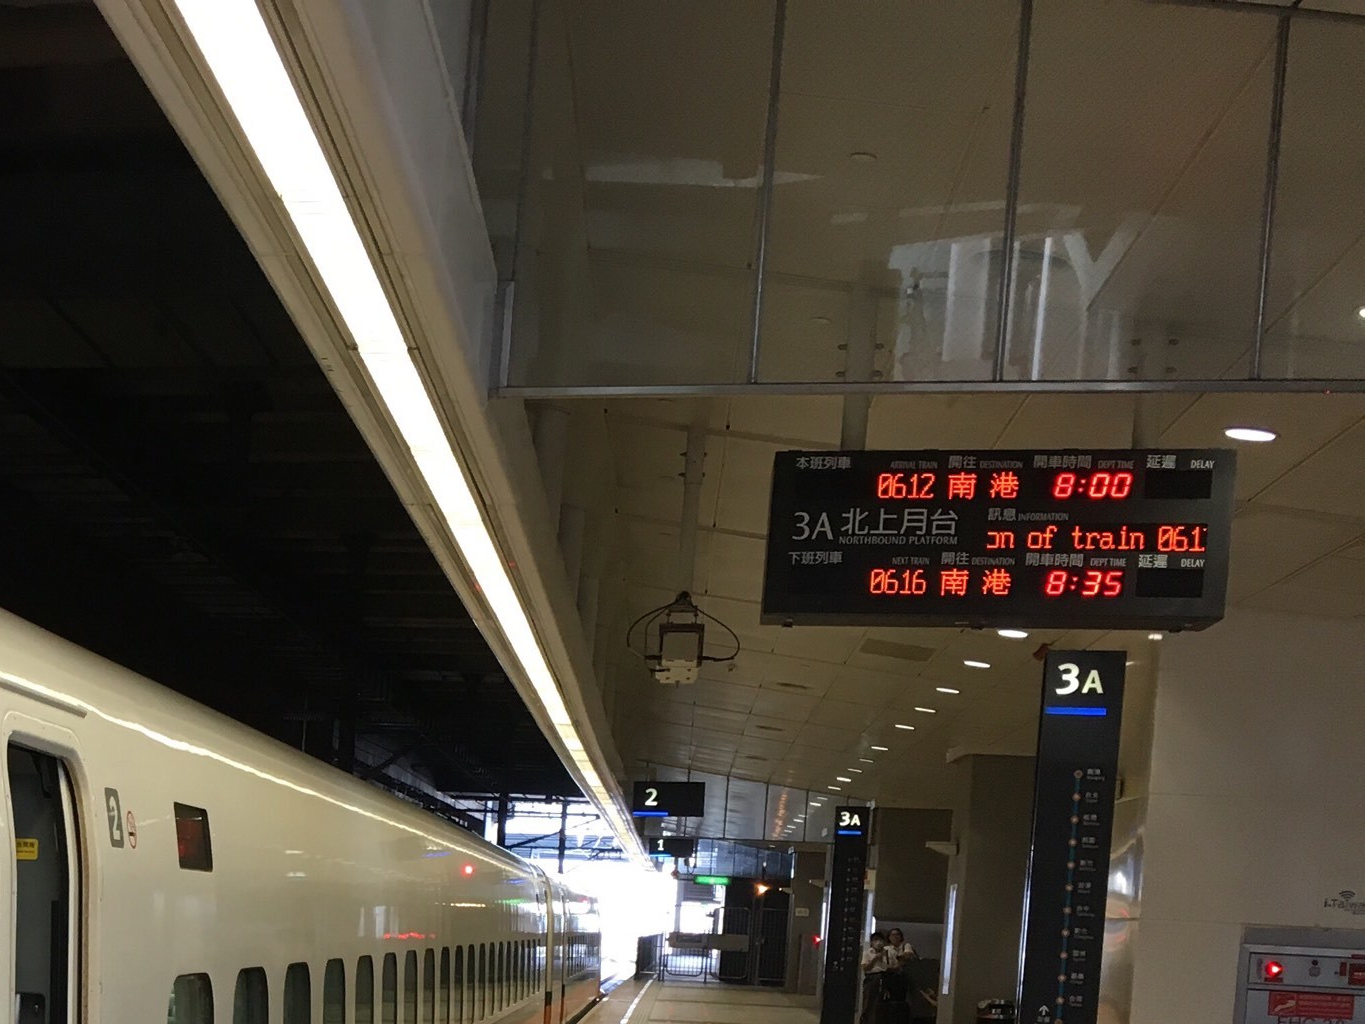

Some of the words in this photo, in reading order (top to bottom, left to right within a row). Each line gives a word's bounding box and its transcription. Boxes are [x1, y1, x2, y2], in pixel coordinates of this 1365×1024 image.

[795, 455, 852, 470] 本班列車
[917, 460, 939, 470] TRAIN
[948, 455, 977, 470] 開往
[979, 460, 1023, 470] DESTINATION
[1033, 455, 1092, 470] 開車時間
[1098, 460, 1115, 470] DEPT
[1116, 460, 1135, 470] TIME
[1190, 459, 1216, 470] DELAY
[877, 472, 935, 500] 0612
[1054, 473, 1133, 499] 8:00
[987, 508, 1017, 522] 訊息
[1018, 511, 1069, 522] INFORMATION
[791, 510, 834, 542] 3A
[840, 507, 960, 536] 北上月台
[838, 535, 906, 545] NORTHBOUND
[908, 535, 958, 546] PLATFORM
[1027, 525, 1056, 550] of
[1072, 526, 1144, 550] train
[1157, 525, 1207, 552] 061
[787, 551, 843, 566] 下班列車
[891, 556, 909, 566] NEXT
[911, 556, 931, 566] TRAIN
[941, 552, 970, 566] 開往
[971, 556, 1016, 566] DESTINATION
[1025, 552, 1084, 568] 開車時間
[1090, 557, 1108, 567] DEPT
[1109, 557, 1127, 567] TIME
[1180, 558, 1206, 568] DELAY
[870, 568, 927, 595] 0616
[1046, 571, 1123, 597] 8:35
[1055, 662, 1104, 696] 3A
[644, 788, 658, 806] 2
[108, 795, 121, 841] 2
[838, 810, 861, 828] 3A
[657, 838, 665, 852] 1
